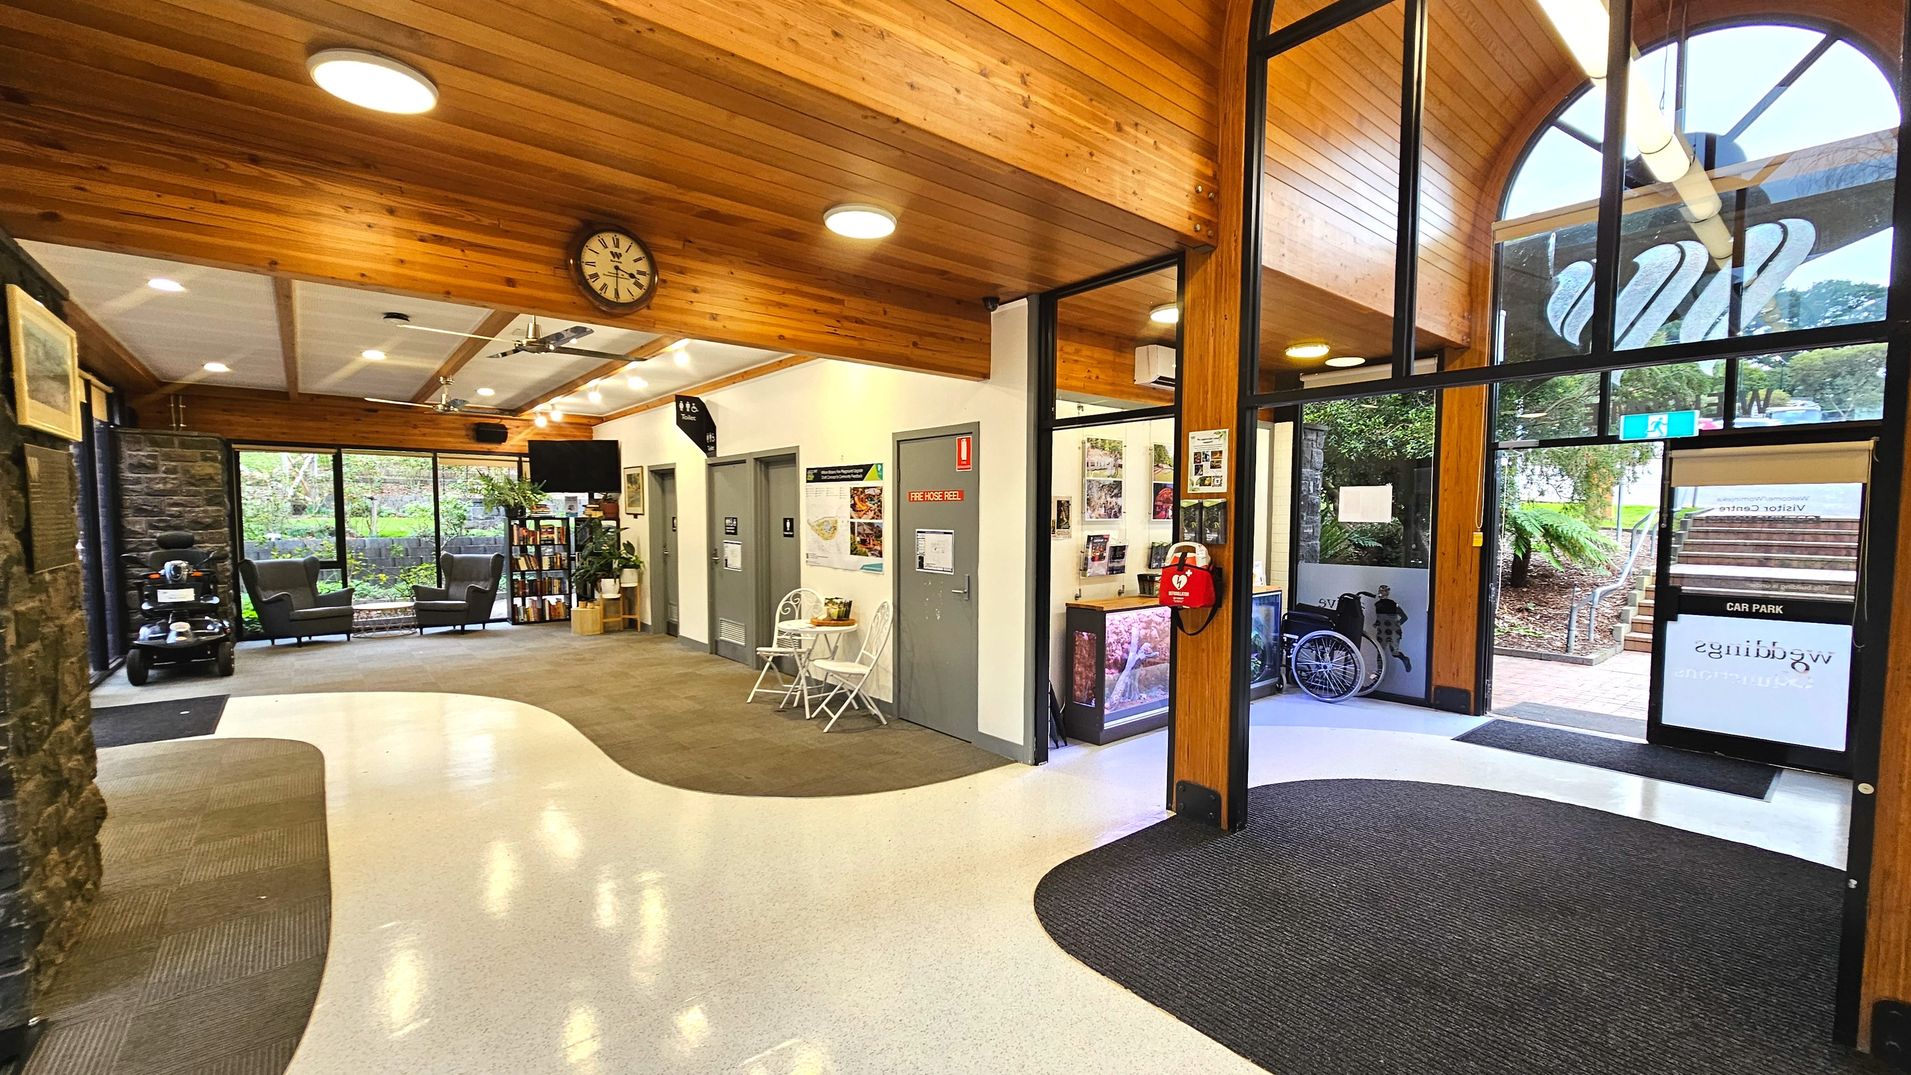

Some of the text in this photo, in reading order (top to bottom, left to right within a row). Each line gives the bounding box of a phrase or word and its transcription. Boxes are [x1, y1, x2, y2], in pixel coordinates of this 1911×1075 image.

[910, 491, 962, 501] FIRE HOSE REEL
[1726, 602, 1783, 614] CAR PARK
